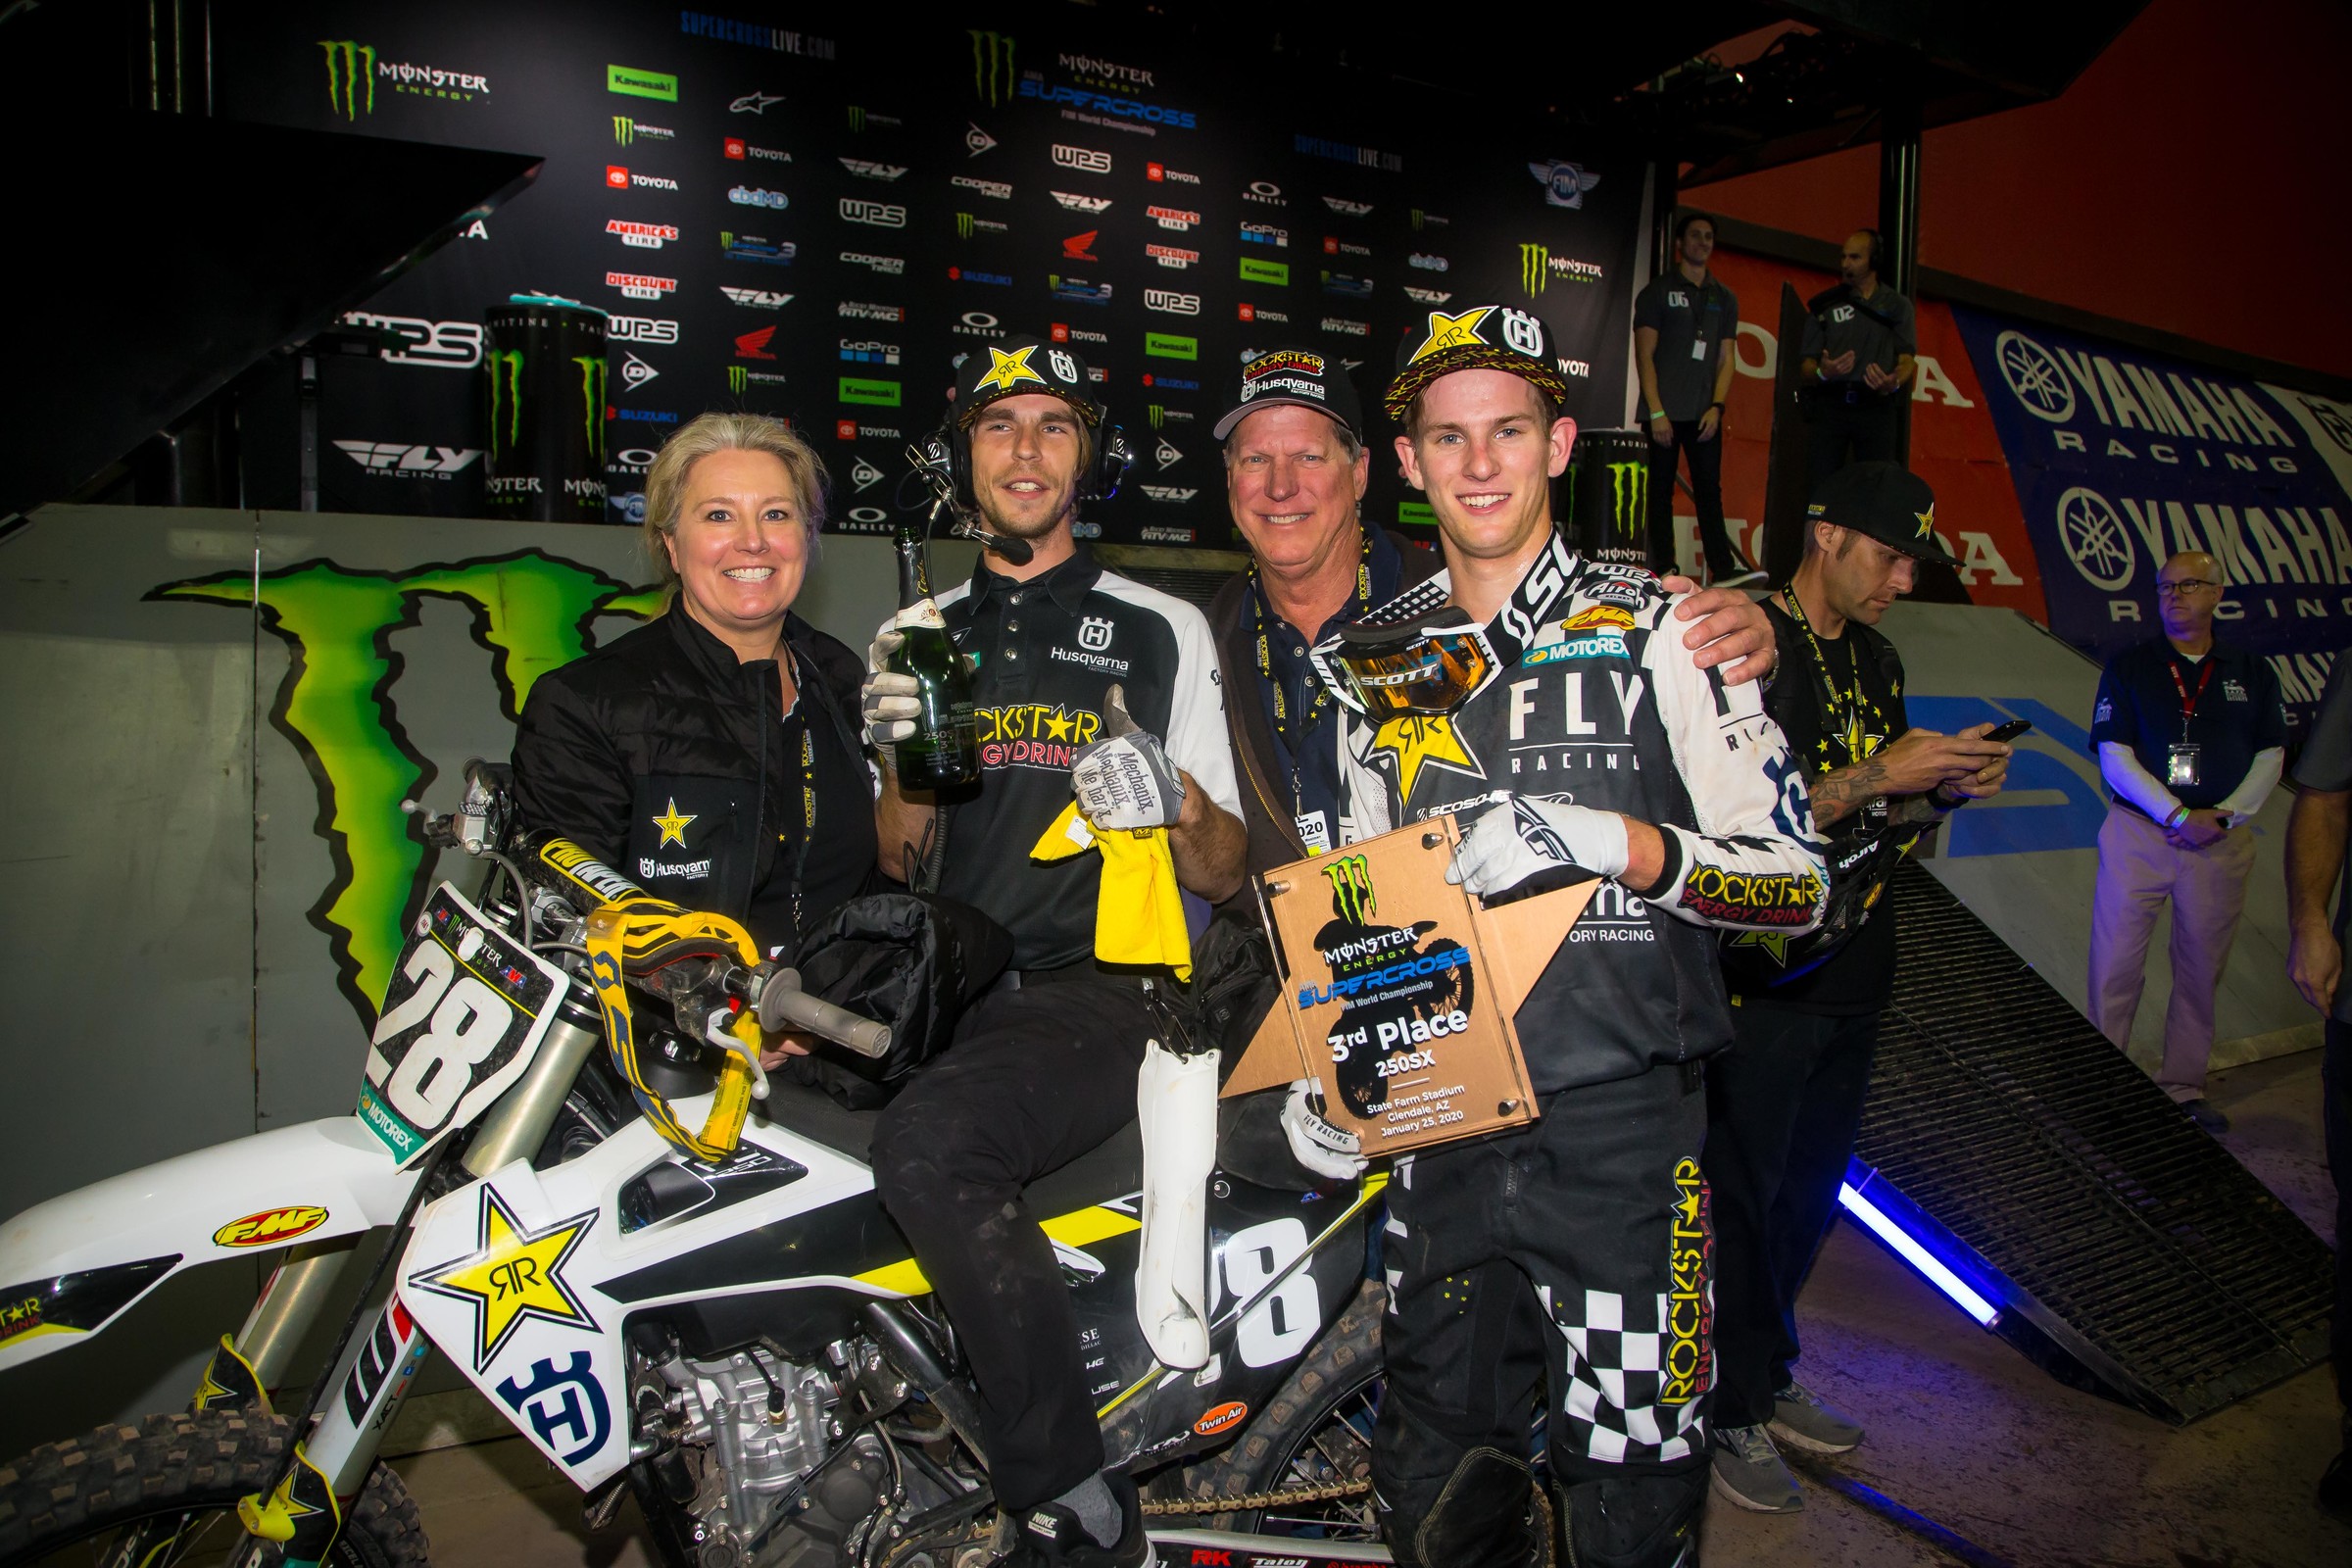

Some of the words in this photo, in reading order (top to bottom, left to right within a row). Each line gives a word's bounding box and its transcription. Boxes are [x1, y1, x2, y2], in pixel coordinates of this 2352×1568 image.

[680, 10, 835, 60] SUPERCROSSLIVE.COM
[378, 62, 490, 93] MONSTER
[1059, 53, 1154, 87] MONSTER
[396, 84, 473, 101] ENERGY
[614, 74, 671, 92] Kawasaki
[1075, 75, 1141, 95] ENERGY
[1019, 80, 1197, 128] SUPERCROSS
[748, 147, 792, 163] TOYOTA
[1052, 144, 1111, 173] WPS
[838, 157, 908, 179] FLY
[1165, 170, 1200, 185] TOYOTA
[631, 174, 678, 191] TOYOTA
[951, 176, 1013, 193] COOPER
[729, 186, 788, 209] cbdMD
[1050, 191, 1112, 212] FLY
[1243, 192, 1288, 207] OAKLEY
[1323, 196, 1374, 216] FLY
[840, 198, 906, 227] WPS
[1148, 206, 1200, 224] AMERICA'S
[608, 221, 677, 239] AMERICA'S
[1161, 219, 1185, 229] TIRE
[1240, 220, 1289, 237] GoPro
[628, 236, 658, 247] TIRE
[1340, 244, 1371, 256] TOYOTA
[840, 252, 905, 268] COOPER
[1148, 245, 1199, 262] DISCOUNT
[1161, 258, 1184, 268] TIRE
[1245, 265, 1285, 278] Kawasaki
[1548, 257, 1602, 277] MONSTER
[609, 274, 675, 291] DISCOUNT
[627, 288, 656, 298] TIRE
[719, 286, 796, 307] FLY
[1145, 289, 1200, 316] WPS
[1403, 286, 1452, 305] FLY
[1255, 310, 1289, 322] TOYOTA
[1833, 305, 1855, 323] 02
[608, 316, 678, 344] WPS
[953, 325, 1006, 338] OAKLEY
[1071, 329, 1107, 343] TOYOTA
[840, 339, 900, 354] GoPro
[1151, 341, 1193, 353] Kawasaki
[845, 385, 895, 400] Kawasaki
[1256, 378, 1324, 394] Husqvarna
[2055, 346, 2296, 448] YAMAHA
[619, 409, 678, 423] SUZUKI
[859, 426, 901, 438] TOYOTA
[333, 440, 485, 472] FLY
[2053, 429, 2298, 473] RACING
[366, 467, 453, 480] RACING
[1139, 485, 1199, 501] FLY
[839, 522, 896, 531] OAKLEY
[1588, 582, 1645, 609] Airoh
[1405, 638, 1430, 651] SCOTT
[1549, 638, 1629, 660] MOTOREX
[1051, 647, 1129, 671] Husqvarna
[1360, 663, 1439, 686] SCOTT
[1509, 671, 1643, 740] FLY
[1093, 745, 1131, 809] Mechanix
[1117, 752, 1154, 814] Mechanix
[1298, 822, 1323, 837] 020
[656, 858, 711, 876] Husqvarn
[1681, 888, 1755, 922] ENERGY
[1756, 906, 1812, 924] DRINK
[1323, 926, 1419, 966] MONSTER
[1599, 929, 1655, 943] RACING
[1344, 949, 1407, 972] ENERGY
[1298, 947, 1472, 1010] SUPERCROSS
[1356, 993, 1379, 1010] World
[1380, 980, 1434, 1003] Championship
[366, 938, 514, 1130] 28
[1327, 1027, 1368, 1063] 3rd
[1376, 1009, 1469, 1051] Place
[1375, 1050, 1437, 1078] 250SX
[1367, 1100, 1393, 1115] State
[1394, 1095, 1420, 1108] Farm
[1421, 1084, 1465, 1101] Stadium
[1388, 1103, 1434, 1122] Glendale,
[1436, 1101, 1450, 1112] AZ
[368, 1102, 416, 1153] MOTOREX
[1303, 1114, 1316, 1127] FLY
[1317, 1124, 1349, 1145] RACING
[1381, 1119, 1420, 1138] January
[1422, 1115, 1439, 1128] 25,
[1440, 1110, 1464, 1124] 2020
[215, 1206, 327, 1247] FMF
[372, 1396, 397, 1430] XACT
[1200, 1412, 1225, 1431] Twin
[1226, 1405, 1243, 1421] Air
[1032, 1513, 1057, 1529] NIKE
[1191, 1549, 1232, 1566] RK
[1251, 1557, 1309, 1568] Talon
